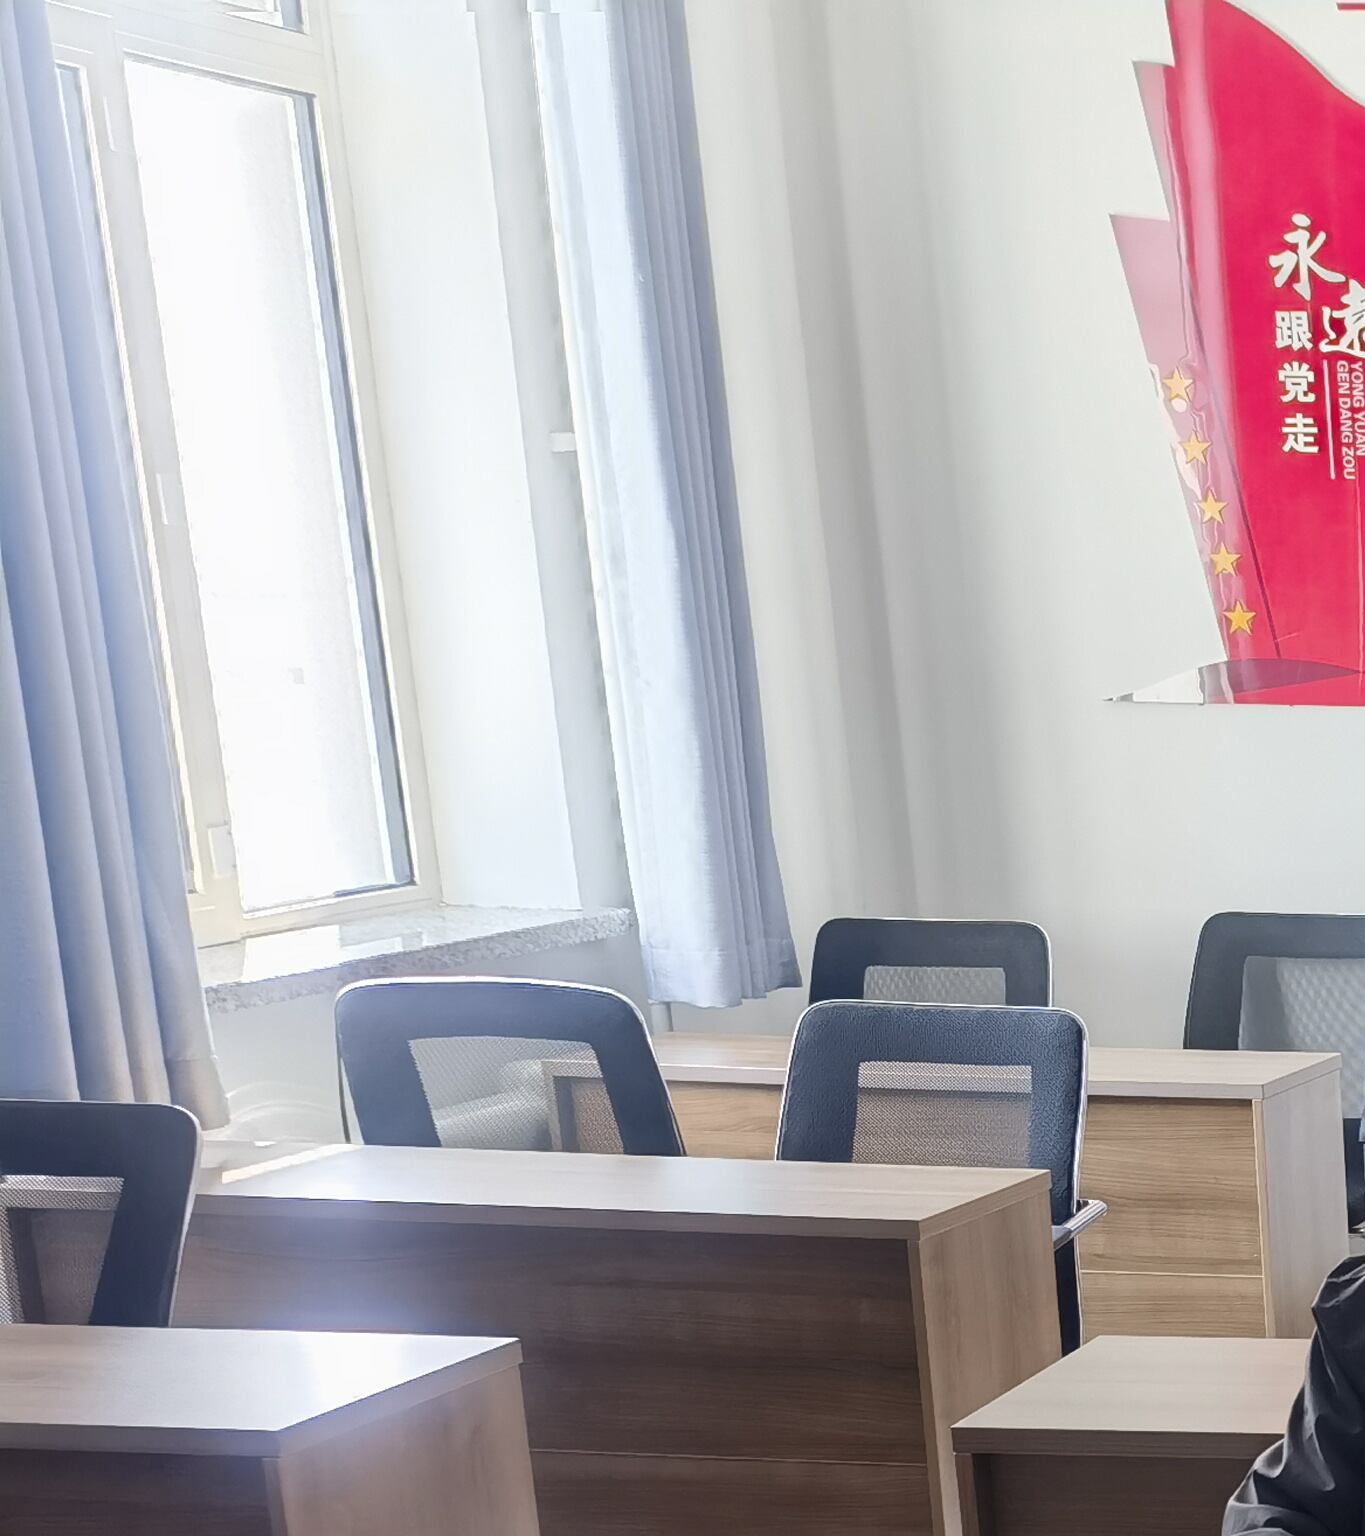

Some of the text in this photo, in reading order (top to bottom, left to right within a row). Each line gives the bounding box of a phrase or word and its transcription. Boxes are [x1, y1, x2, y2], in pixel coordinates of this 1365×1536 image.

[1274, 310, 1320, 453] 跟党走
[1336, 360, 1355, 480] GEN DANG ZOU
[1351, 361, 1365, 407] YONG
